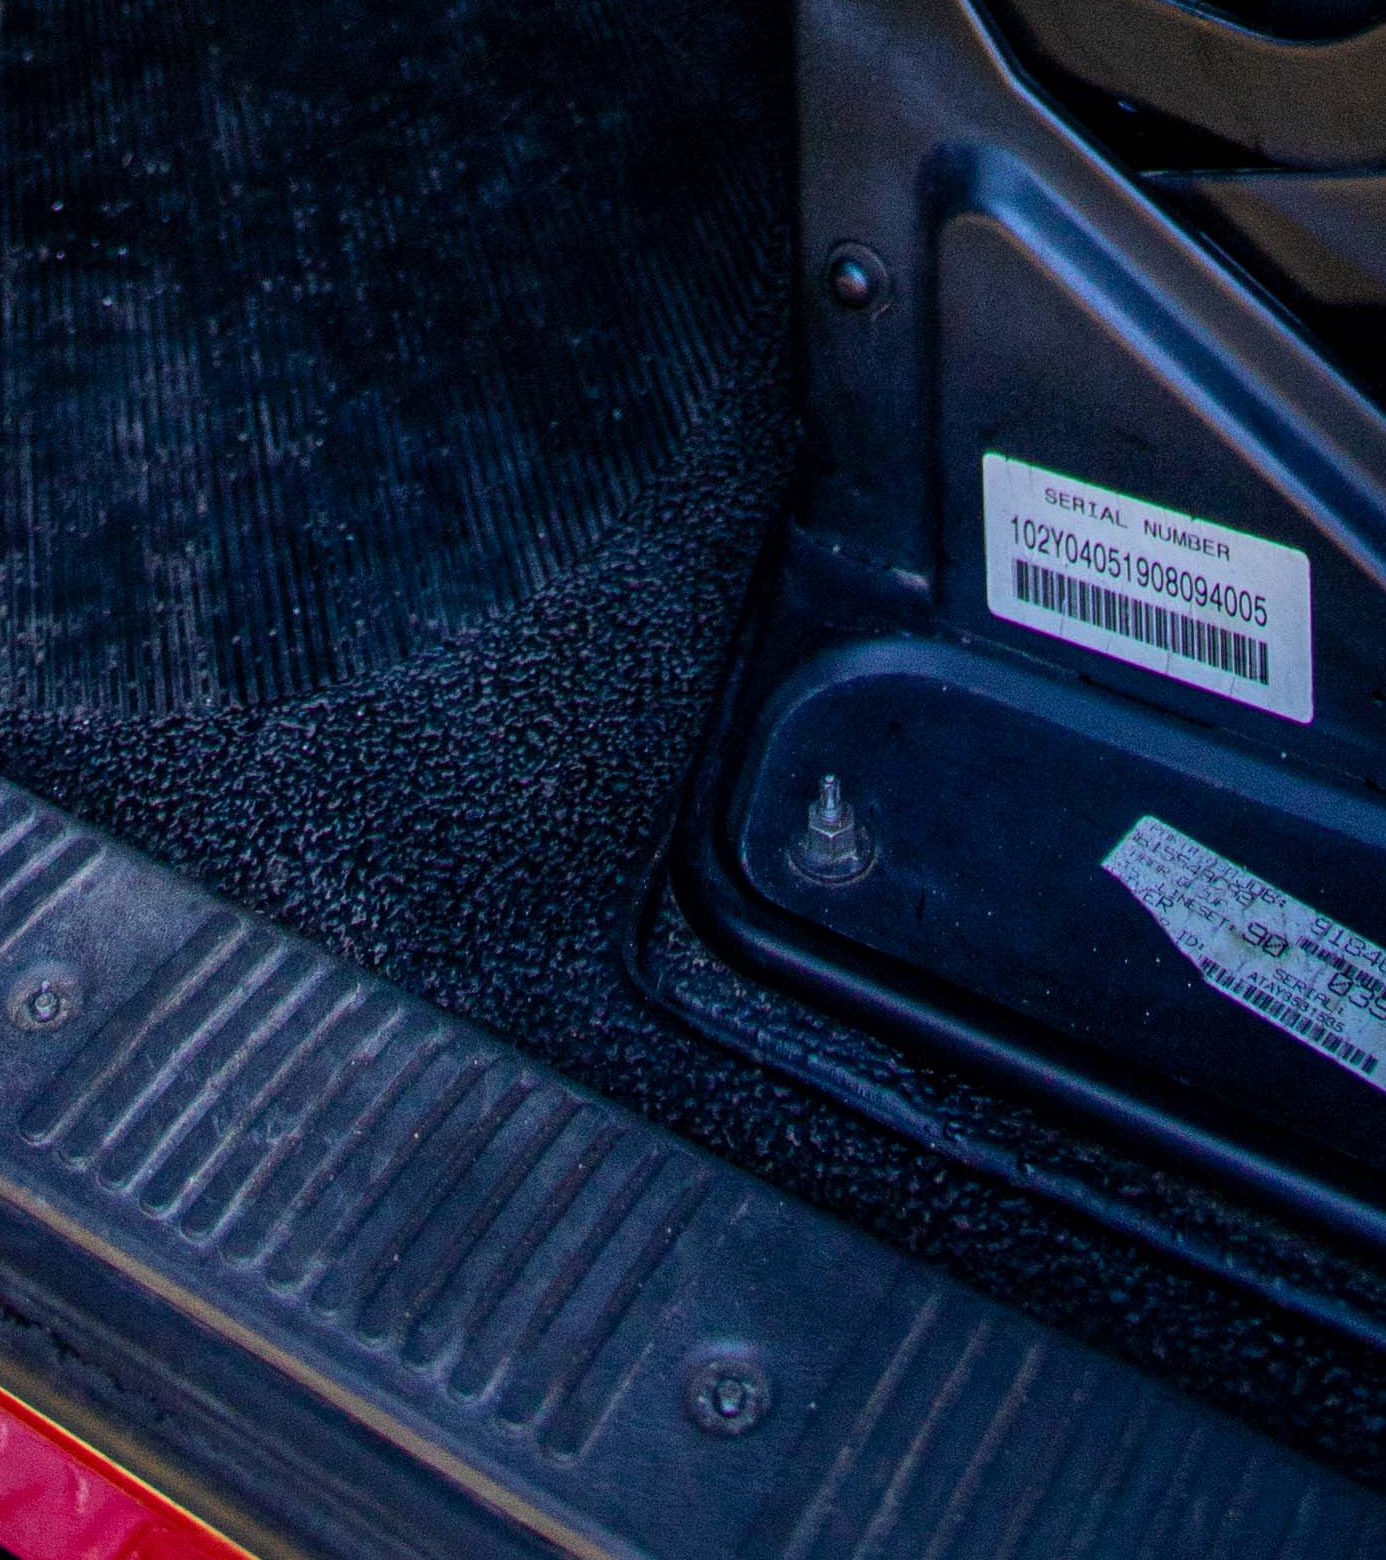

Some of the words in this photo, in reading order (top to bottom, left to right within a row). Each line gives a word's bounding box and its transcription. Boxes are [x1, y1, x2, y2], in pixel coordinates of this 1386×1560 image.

[1044, 487, 1128, 529] SERIAL
[1143, 519, 1230, 561] NUMBER
[1011, 516, 1267, 627] 102Y04051908094005
[1242, 921, 1288, 958] 90
[1273, 967, 1344, 1015] SERIAL:
